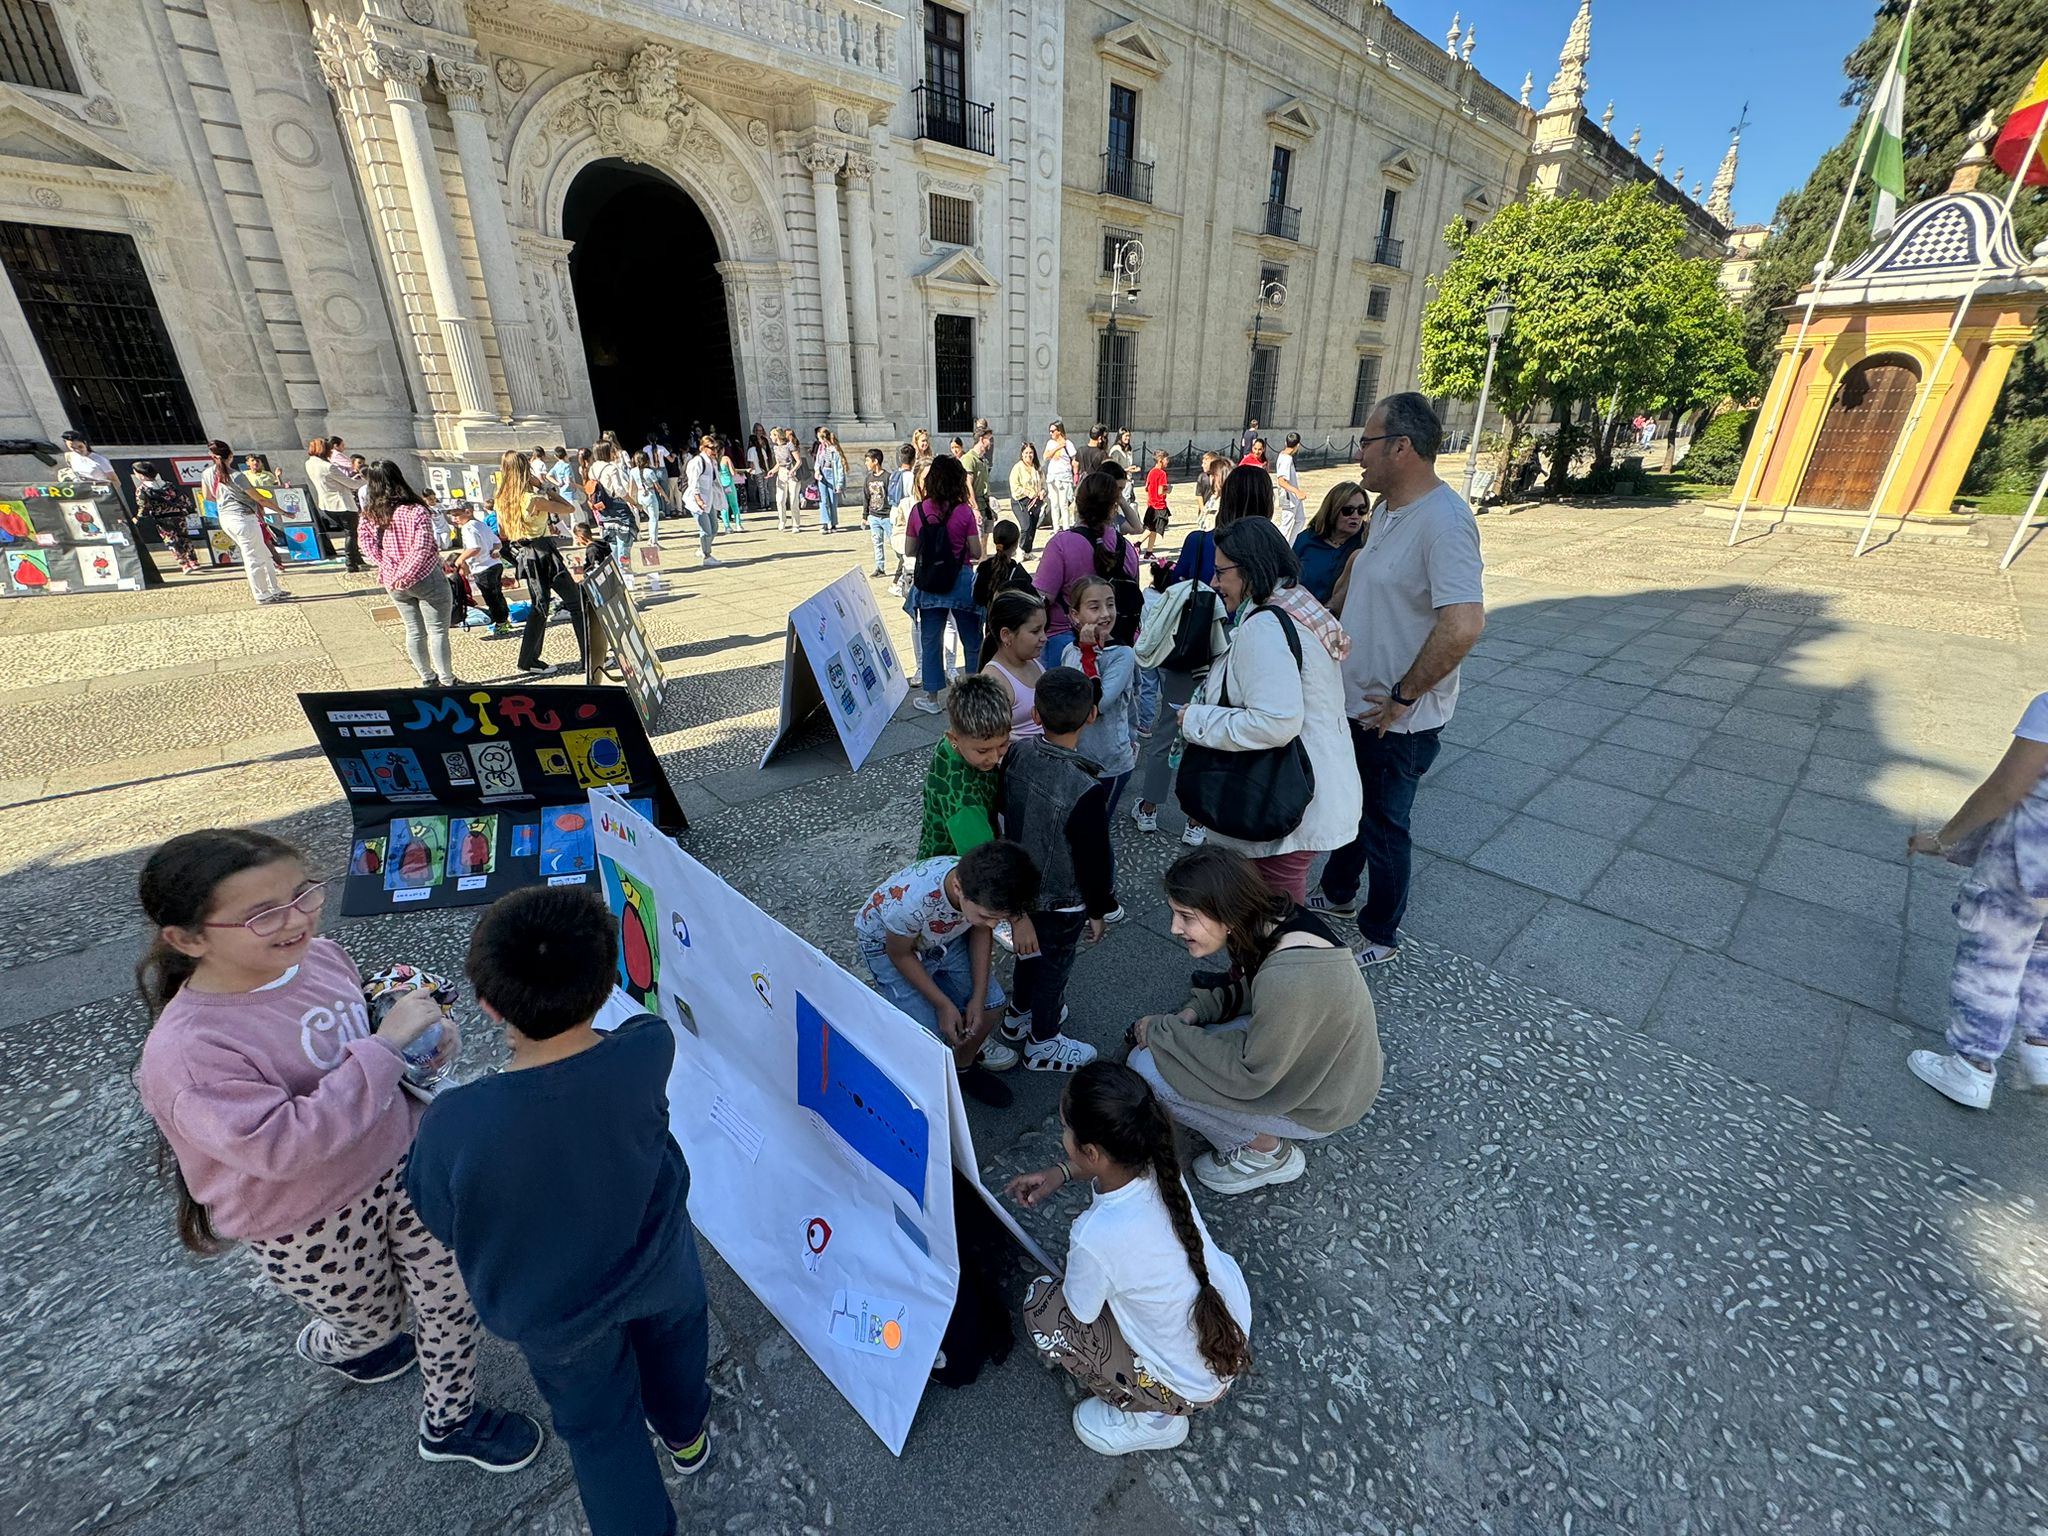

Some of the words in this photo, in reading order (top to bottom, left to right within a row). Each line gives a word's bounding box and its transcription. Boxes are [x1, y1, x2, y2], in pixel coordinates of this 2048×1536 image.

[24, 484, 75, 497] MIRÓ
[601, 812, 637, 847] JOAN
[1028, 1039, 1082, 1063] AIR
